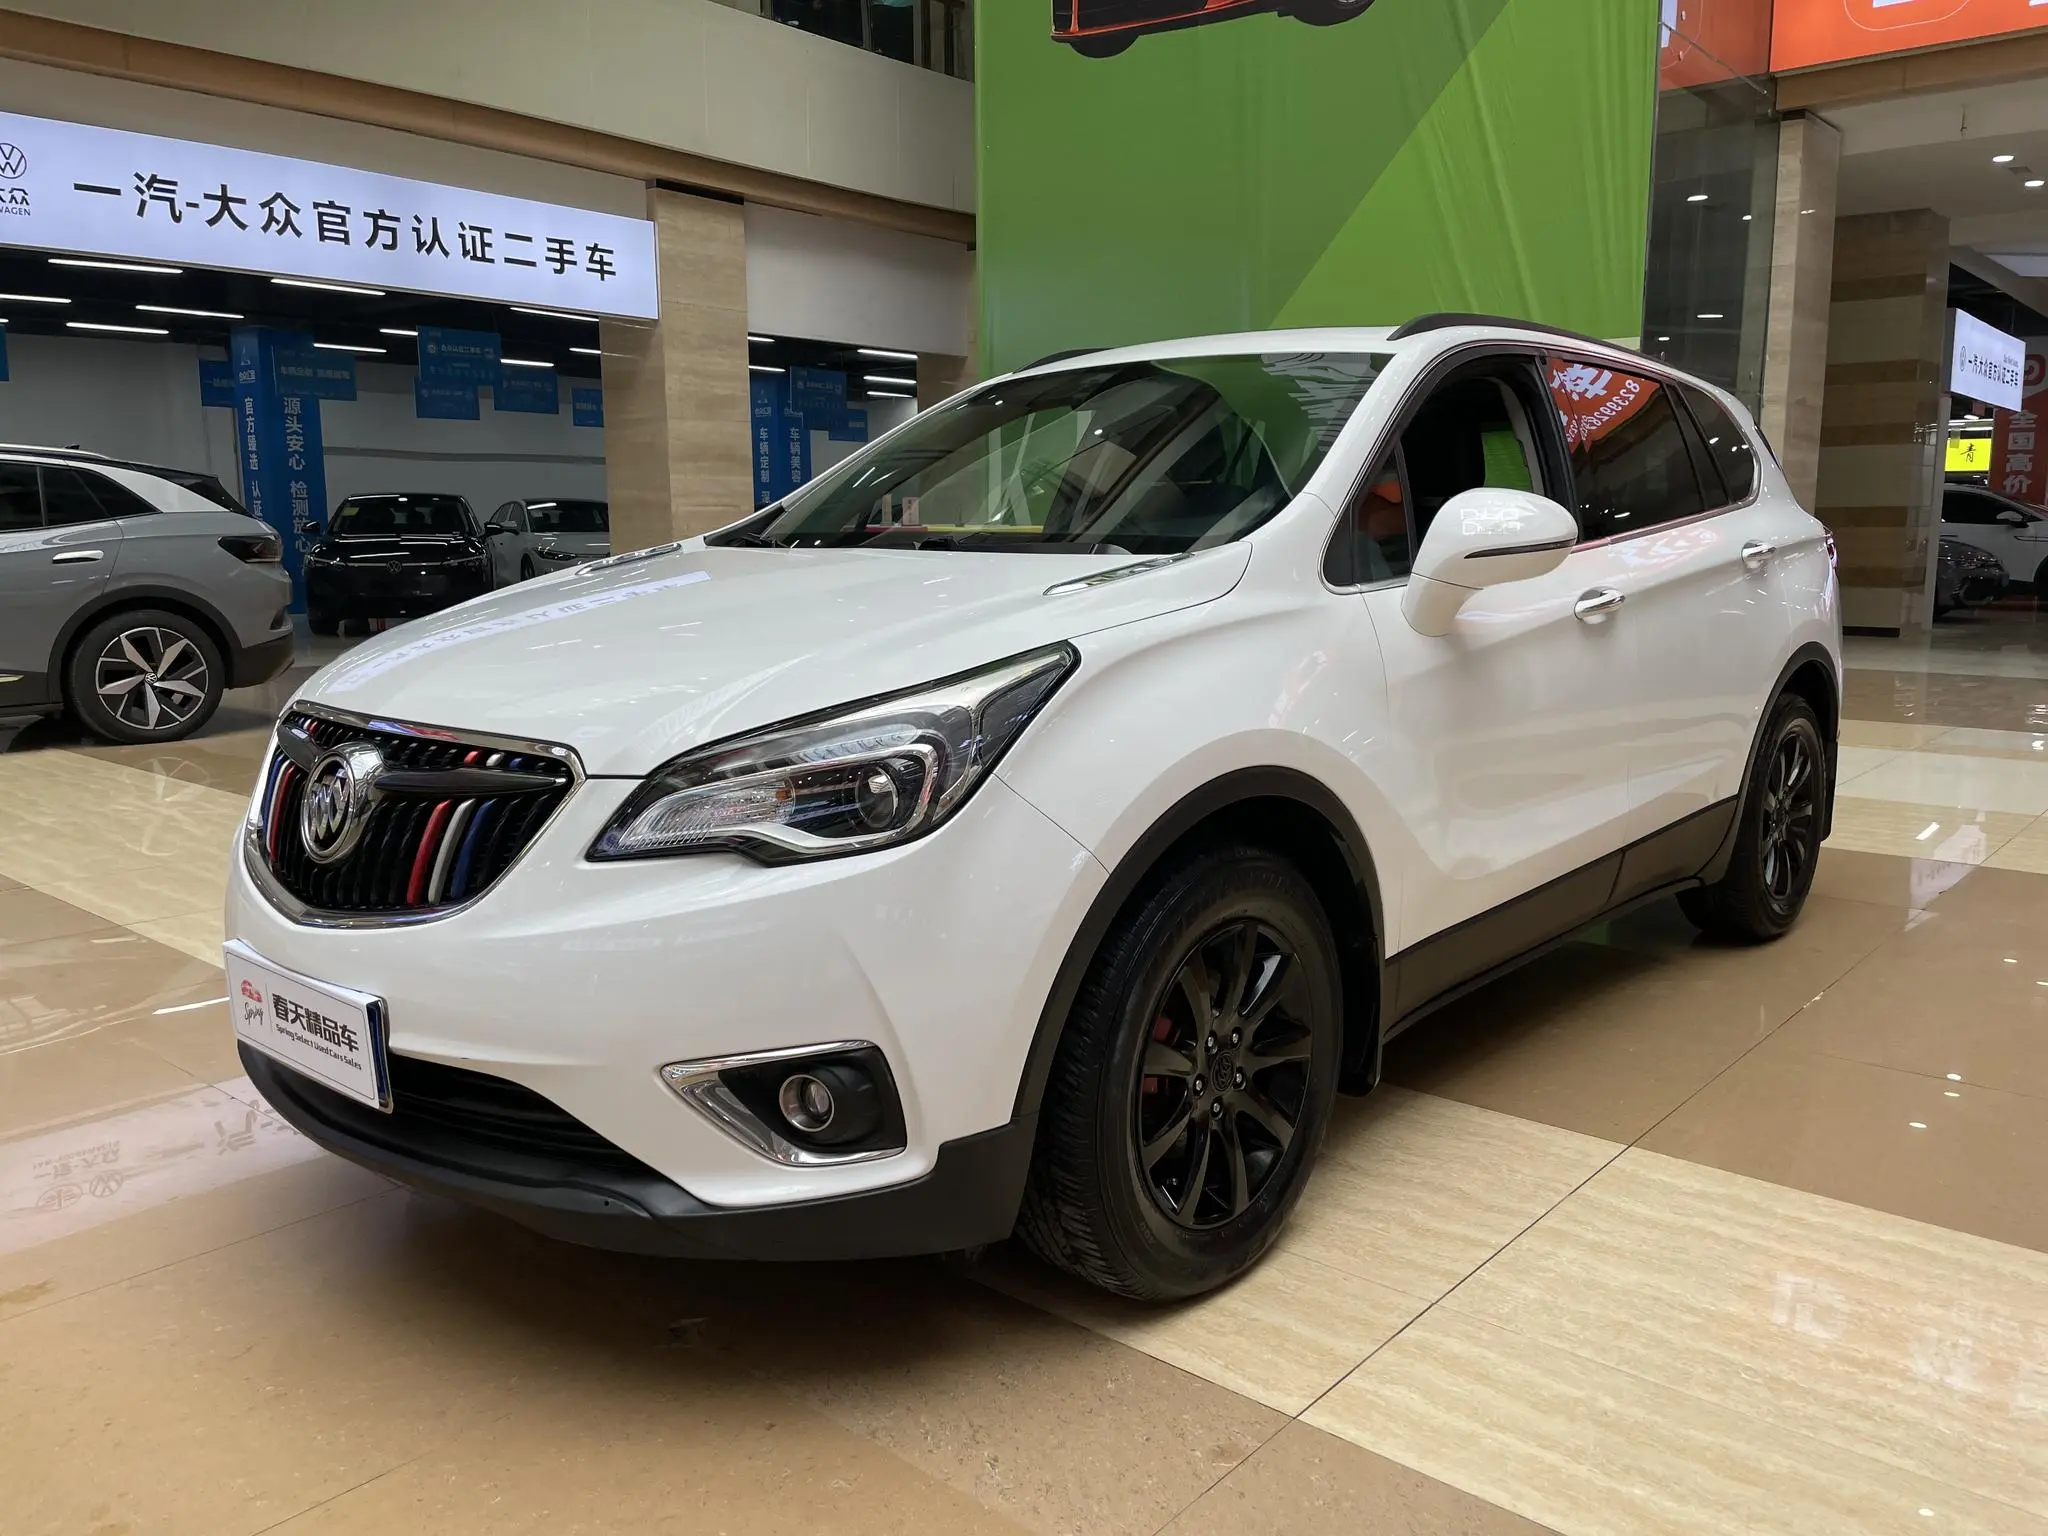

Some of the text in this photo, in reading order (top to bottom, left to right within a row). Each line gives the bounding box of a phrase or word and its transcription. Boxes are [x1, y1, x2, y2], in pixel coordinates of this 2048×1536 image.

[73, 171, 616, 281] 一汽-大众官方认证二手车
[283, 396, 306, 471] 源头安心
[244, 1001, 264, 1026] Spring
[272, 993, 359, 1052] 春天精品车
[276, 1023, 362, 1071] Spring Select Used Cars Sales
